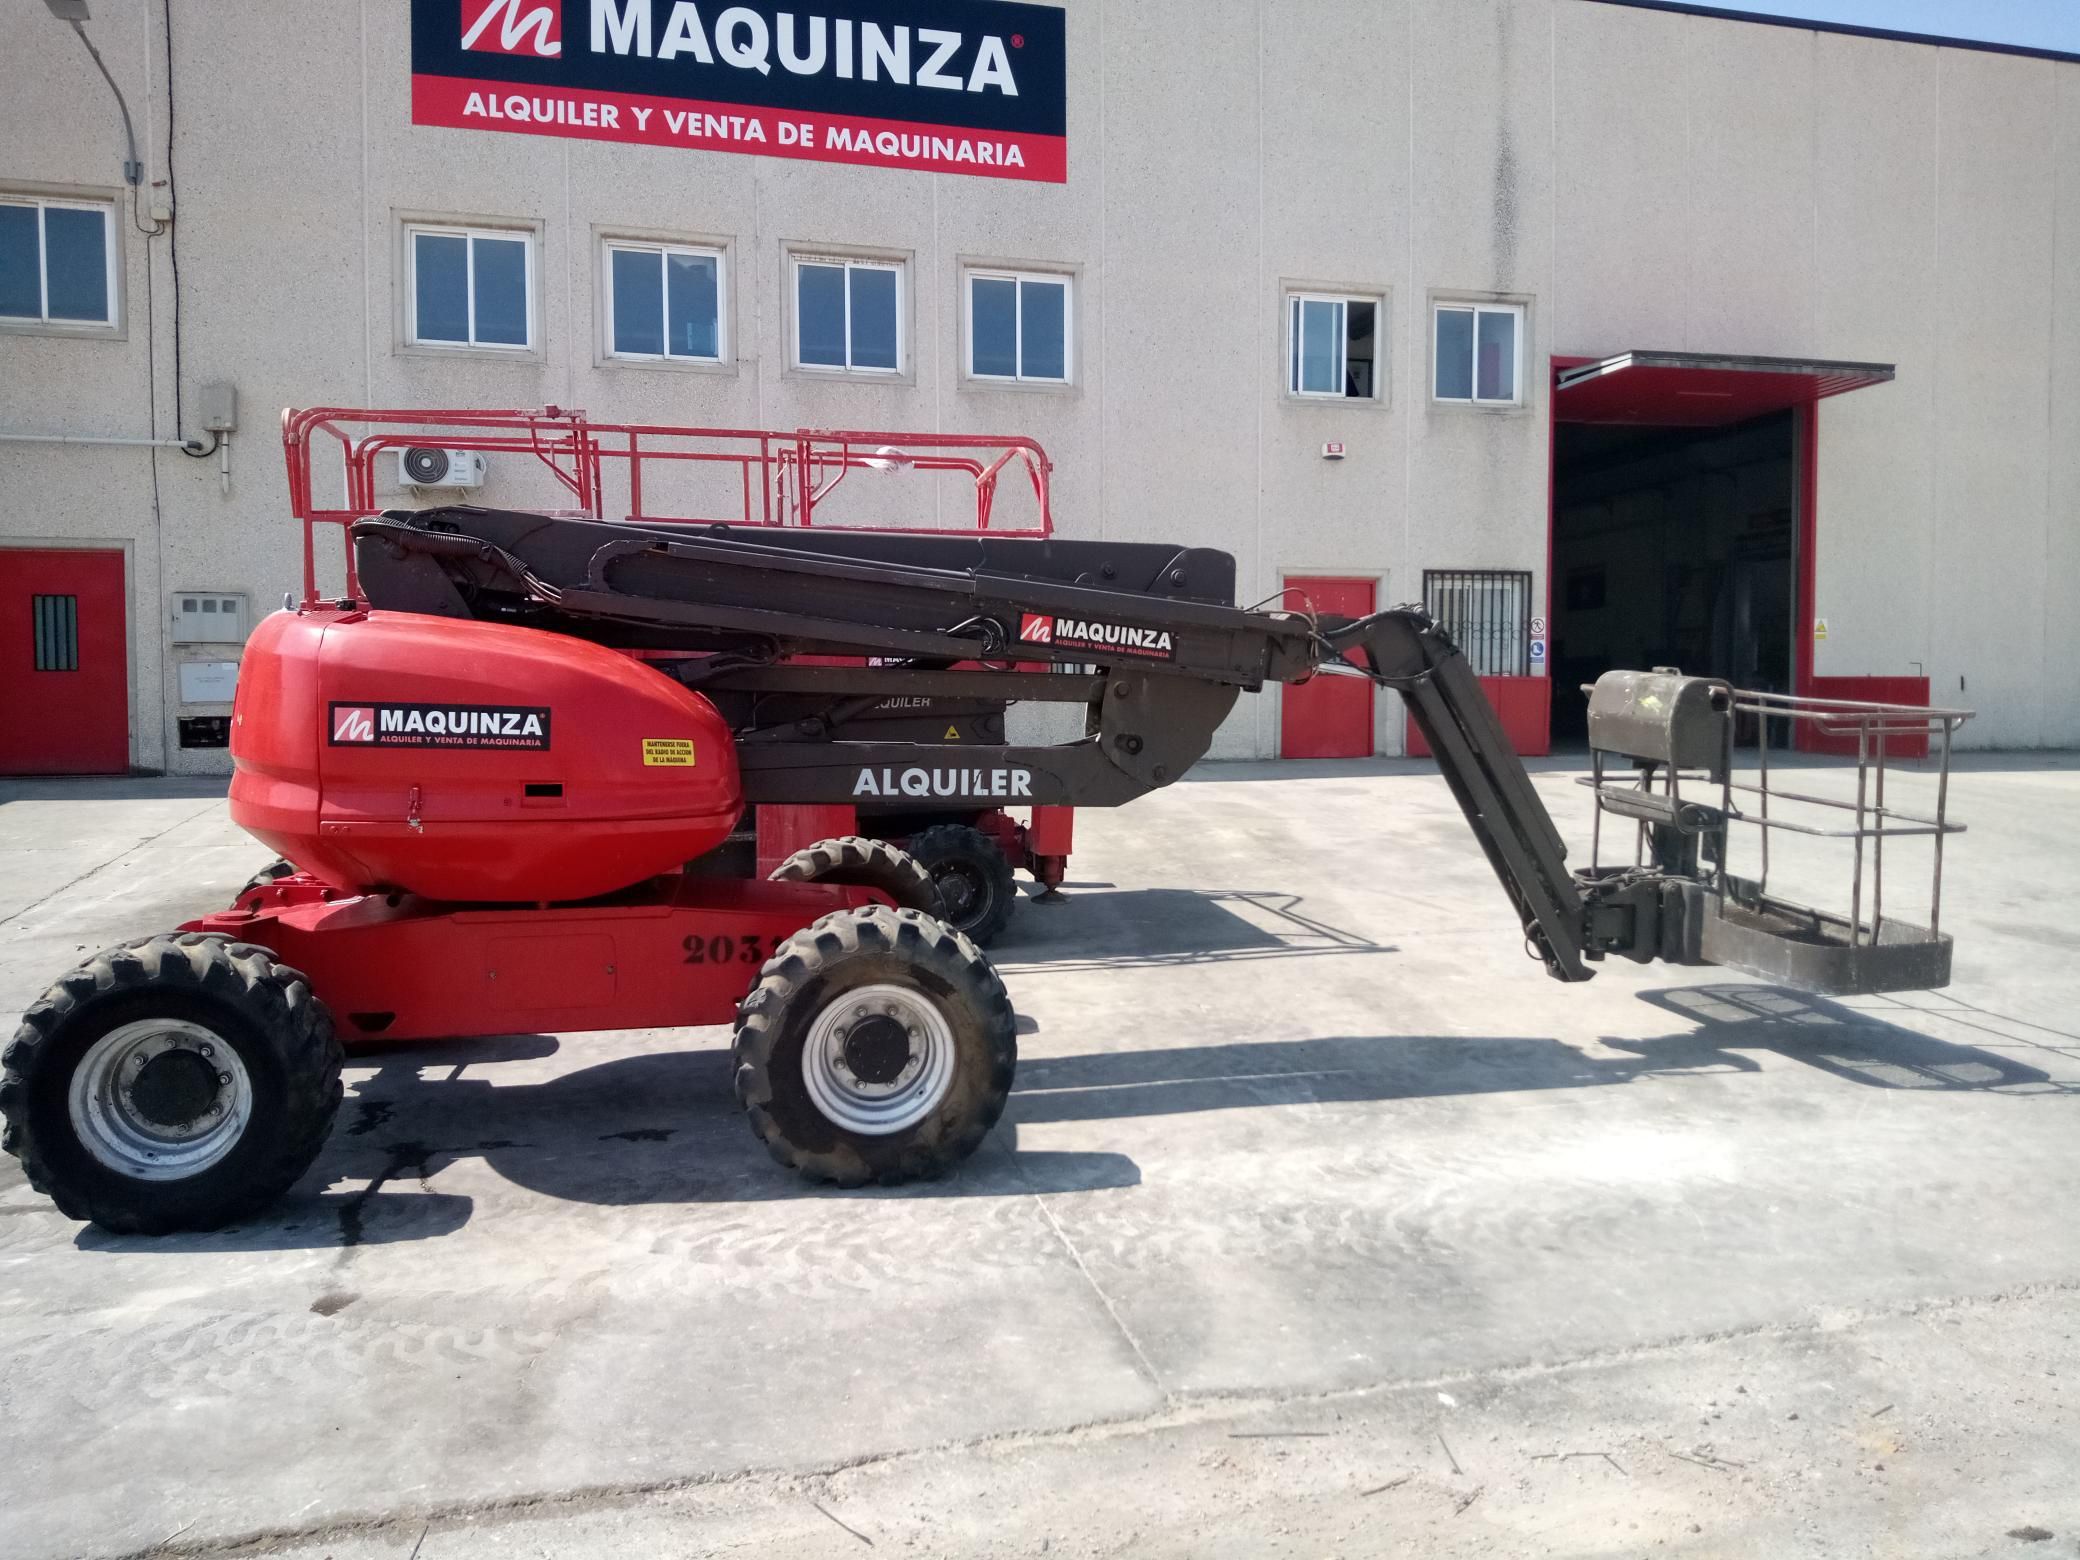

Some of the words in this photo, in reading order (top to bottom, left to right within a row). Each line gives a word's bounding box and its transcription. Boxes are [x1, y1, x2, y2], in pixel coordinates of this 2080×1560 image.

[589, 0, 1020, 97] MAQUINZA
[462, 91, 620, 130] ALQUILER
[630, 107, 655, 133] Y
[663, 109, 768, 144] VENTA
[778, 121, 815, 149] DE
[825, 126, 1026, 169] MAQUINARIA
[1055, 619, 1172, 650] MAQUINZA
[1055, 638, 1086, 648] ALQUILER
[1094, 644, 1115, 652] VENTA
[1126, 647, 1170, 658] MAQUINARIA
[379, 709, 543, 736] MAQUINZA
[380, 735, 423, 744] ALQUILER
[434, 736, 464, 745] VENTA
[480, 738, 542, 747] MAQUINARIA
[852, 767, 1033, 798] ALQUILER
